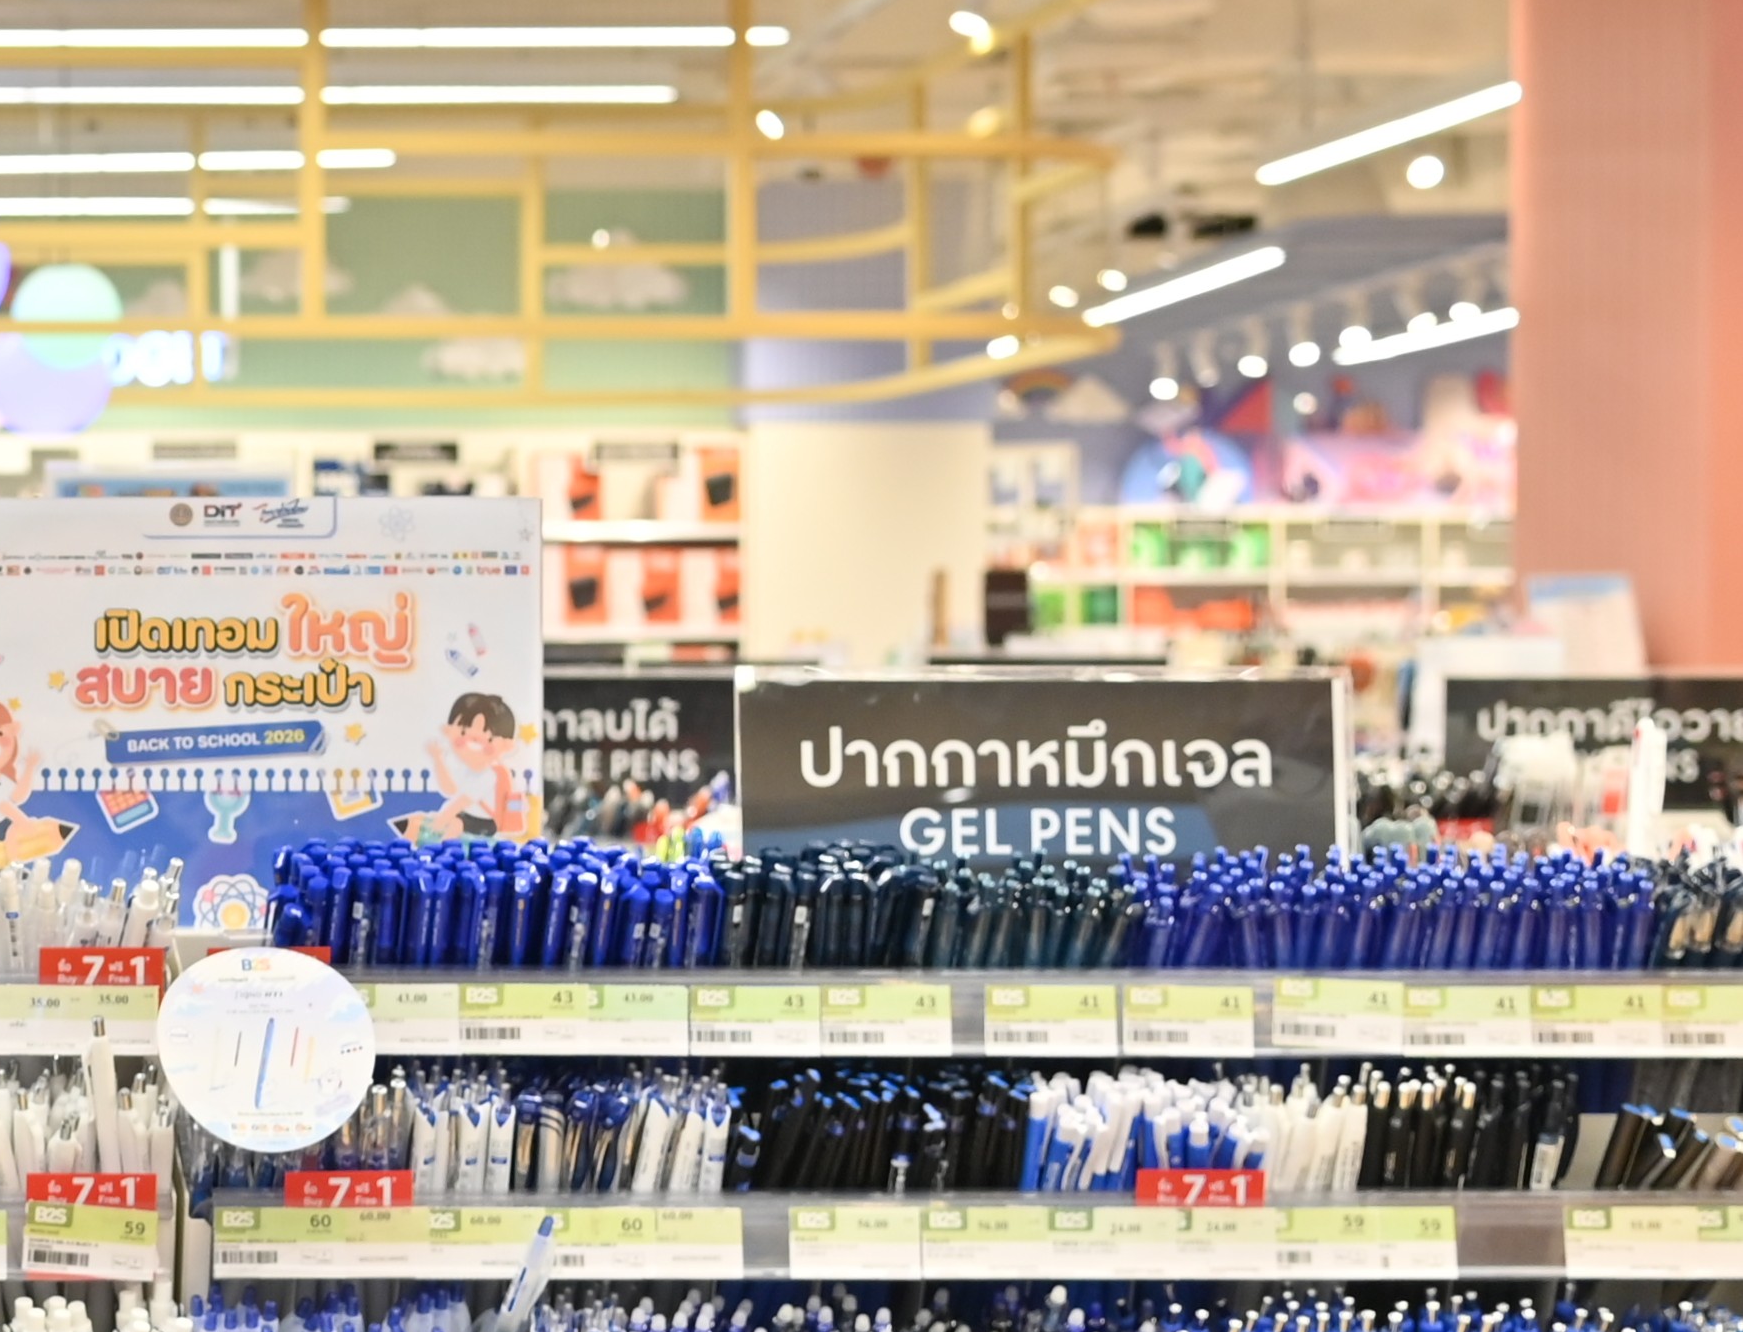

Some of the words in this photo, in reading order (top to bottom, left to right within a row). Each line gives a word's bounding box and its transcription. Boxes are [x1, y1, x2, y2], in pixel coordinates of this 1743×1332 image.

[95, 607, 278, 656] เปิดเทอม
[281, 591, 413, 667] ใหญ่
[74, 665, 215, 707] สบาย
[224, 656, 375, 710] กระเป๋า
[127, 737, 170, 753] BACK
[173, 736, 194, 751] TO
[197, 732, 260, 751] SCHOOL
[264, 728, 304, 746] 2026
[800, 719, 1273, 788] ปากกาหมึกเจล
[610, 748, 700, 782] PENS
[900, 808, 1012, 856] GEL
[1030, 808, 1176, 856] PENS
[81, 955, 105, 984] 7
[129, 955, 146, 984] 1
[552, 990, 573, 1004] 43
[327, 1177, 352, 1207] 7
[376, 1177, 392, 1207] 1
[34, 1205, 67, 1224] B2S
[124, 1220, 146, 1236] 59
[309, 1214, 332, 1229] 60
[620, 1217, 643, 1233] 60
